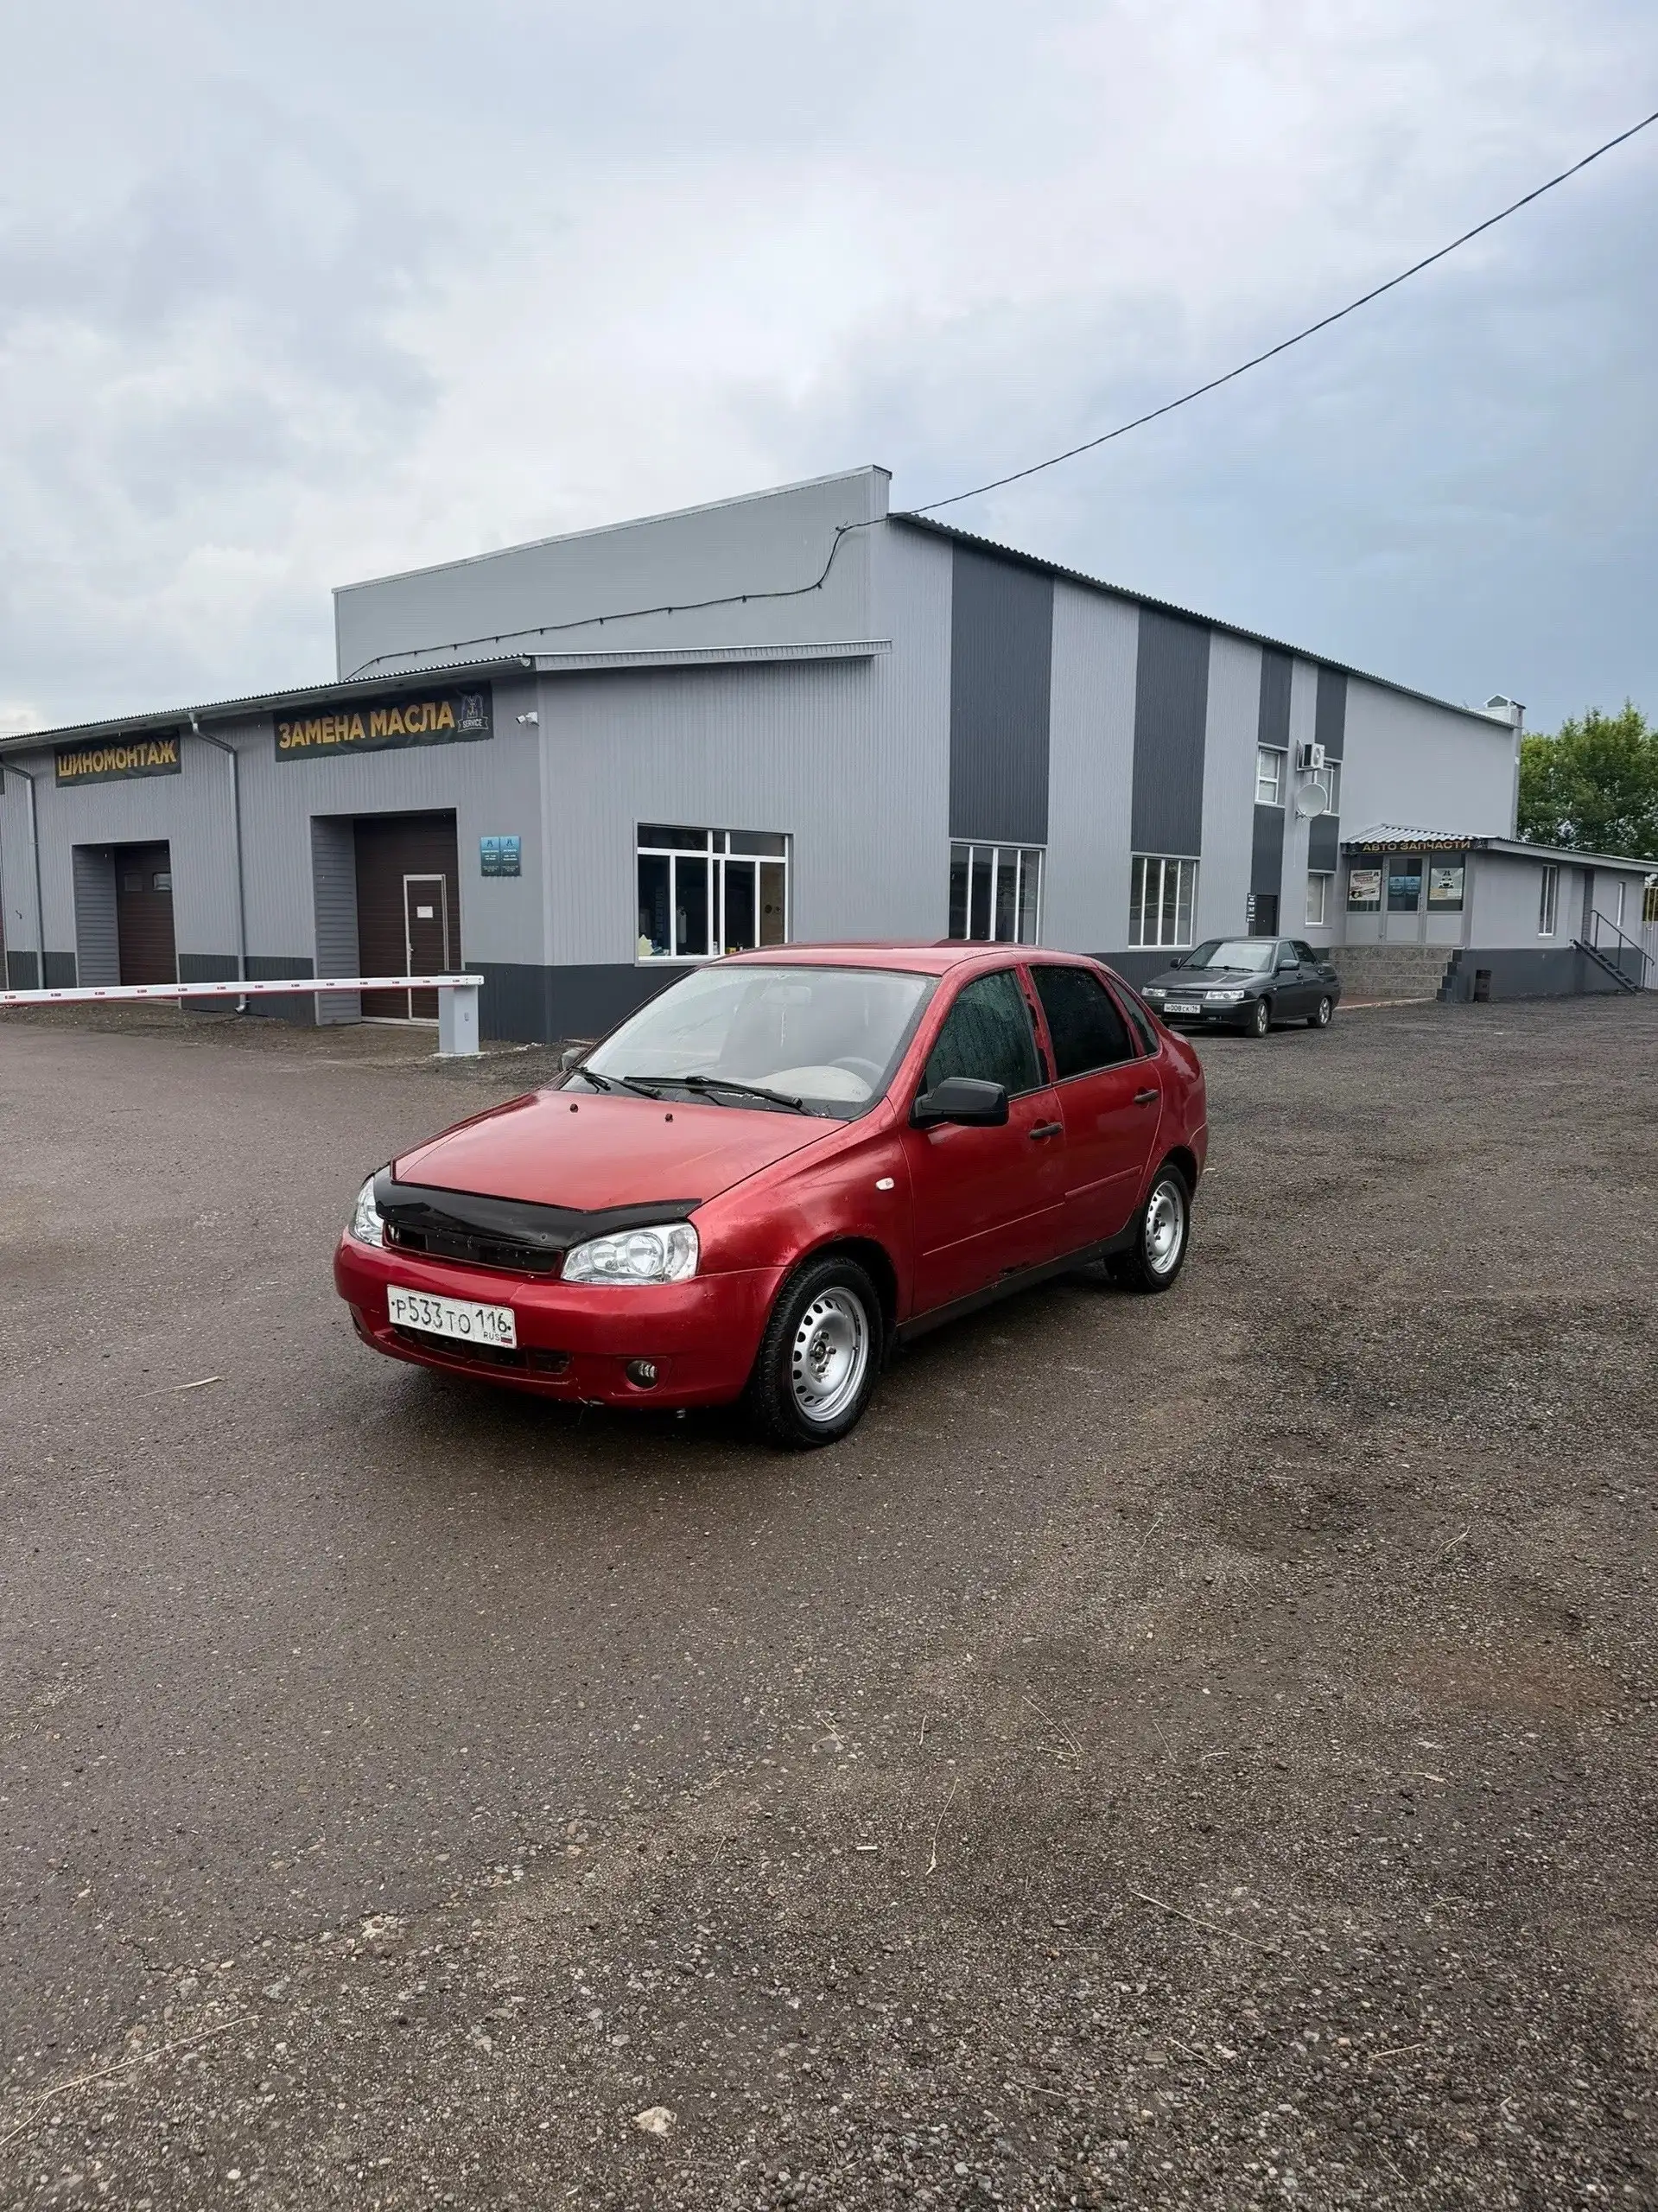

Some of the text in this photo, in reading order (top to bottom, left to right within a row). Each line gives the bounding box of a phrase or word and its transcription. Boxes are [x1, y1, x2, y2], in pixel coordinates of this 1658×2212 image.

[278, 701, 455, 749] ЗАМЕНА МАСЛА
[462, 718, 483, 728] SERVICE
[58, 740, 177, 777] ШИНОМОНТАЖ
[1363, 841, 1471, 852] АВТО ЗАПЧАСТИ
[475, 1309, 508, 1333] 116
[483, 1331, 501, 1342] RUS
